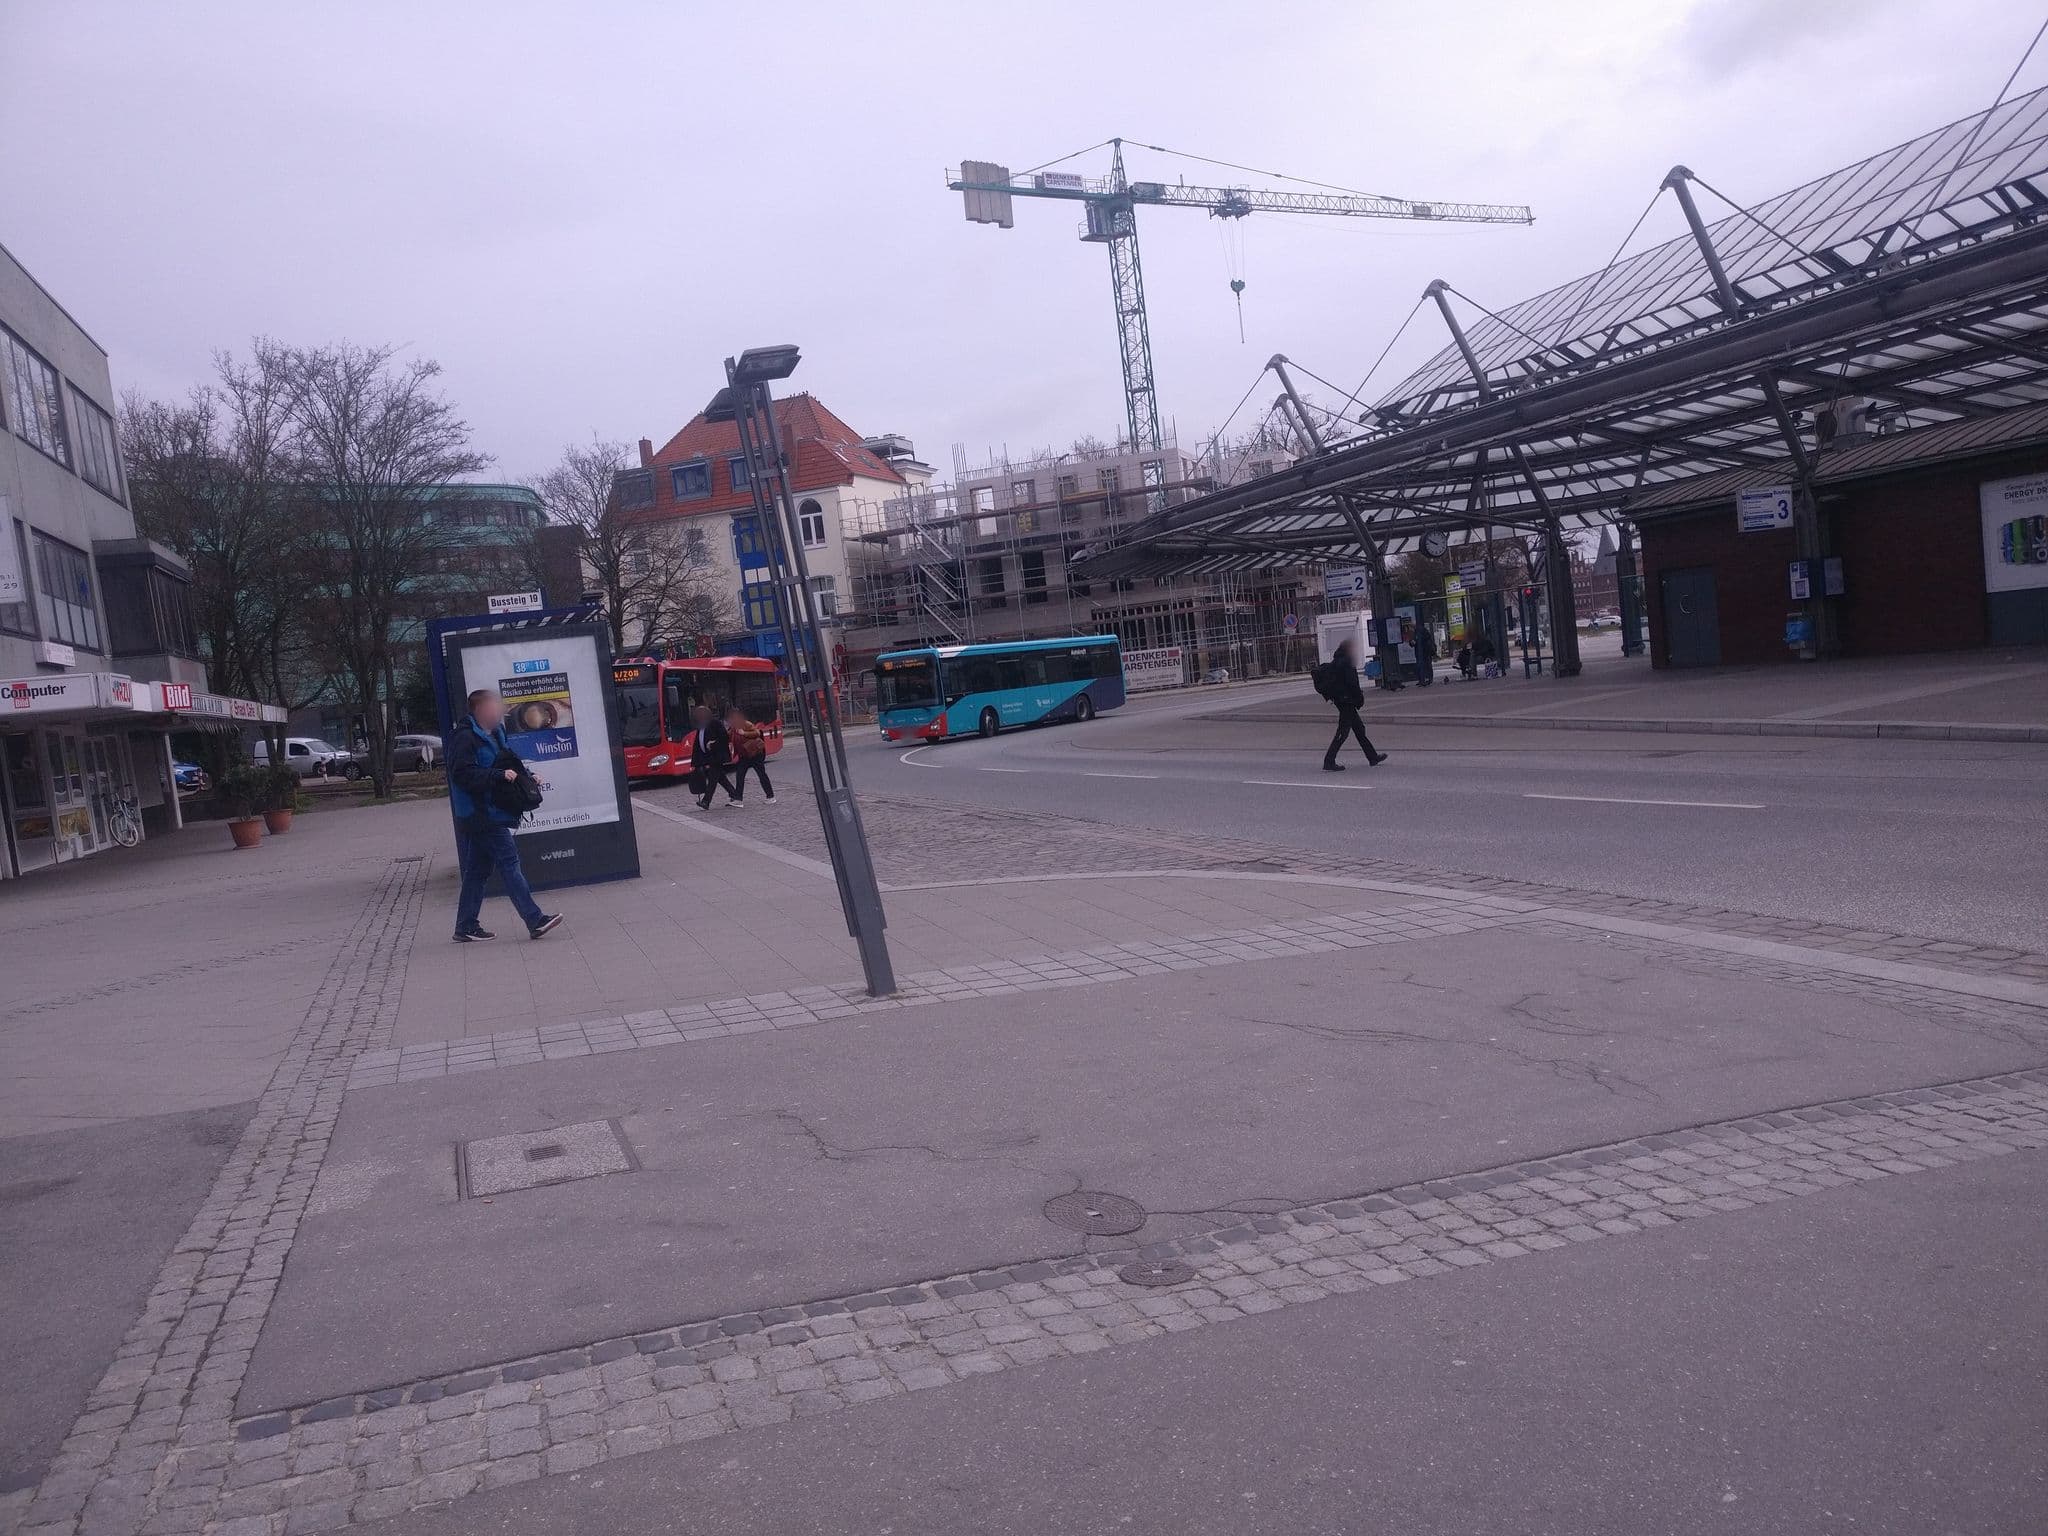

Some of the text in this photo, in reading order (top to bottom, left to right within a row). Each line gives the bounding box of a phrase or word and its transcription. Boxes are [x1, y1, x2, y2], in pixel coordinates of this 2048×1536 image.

[2004, 486, 2048, 500] ENERGY DR
[1778, 499, 1789, 520] 3
[1354, 576, 1364, 591] 2
[491, 594, 538, 607] Bussteig 19
[1129, 650, 1168, 662] DENKER
[1124, 658, 1181, 671] ARSTENSEN
[501, 675, 566, 689] Rauchen erhöht das
[1, 684, 67, 699] Computer
[166, 685, 190, 708] Bild
[502, 689, 523, 697] Risiko
[533, 685, 565, 694] erblinden
[536, 741, 572, 754] Winston
[564, 812, 590, 823] tödlich
[551, 849, 575, 859] Wall
